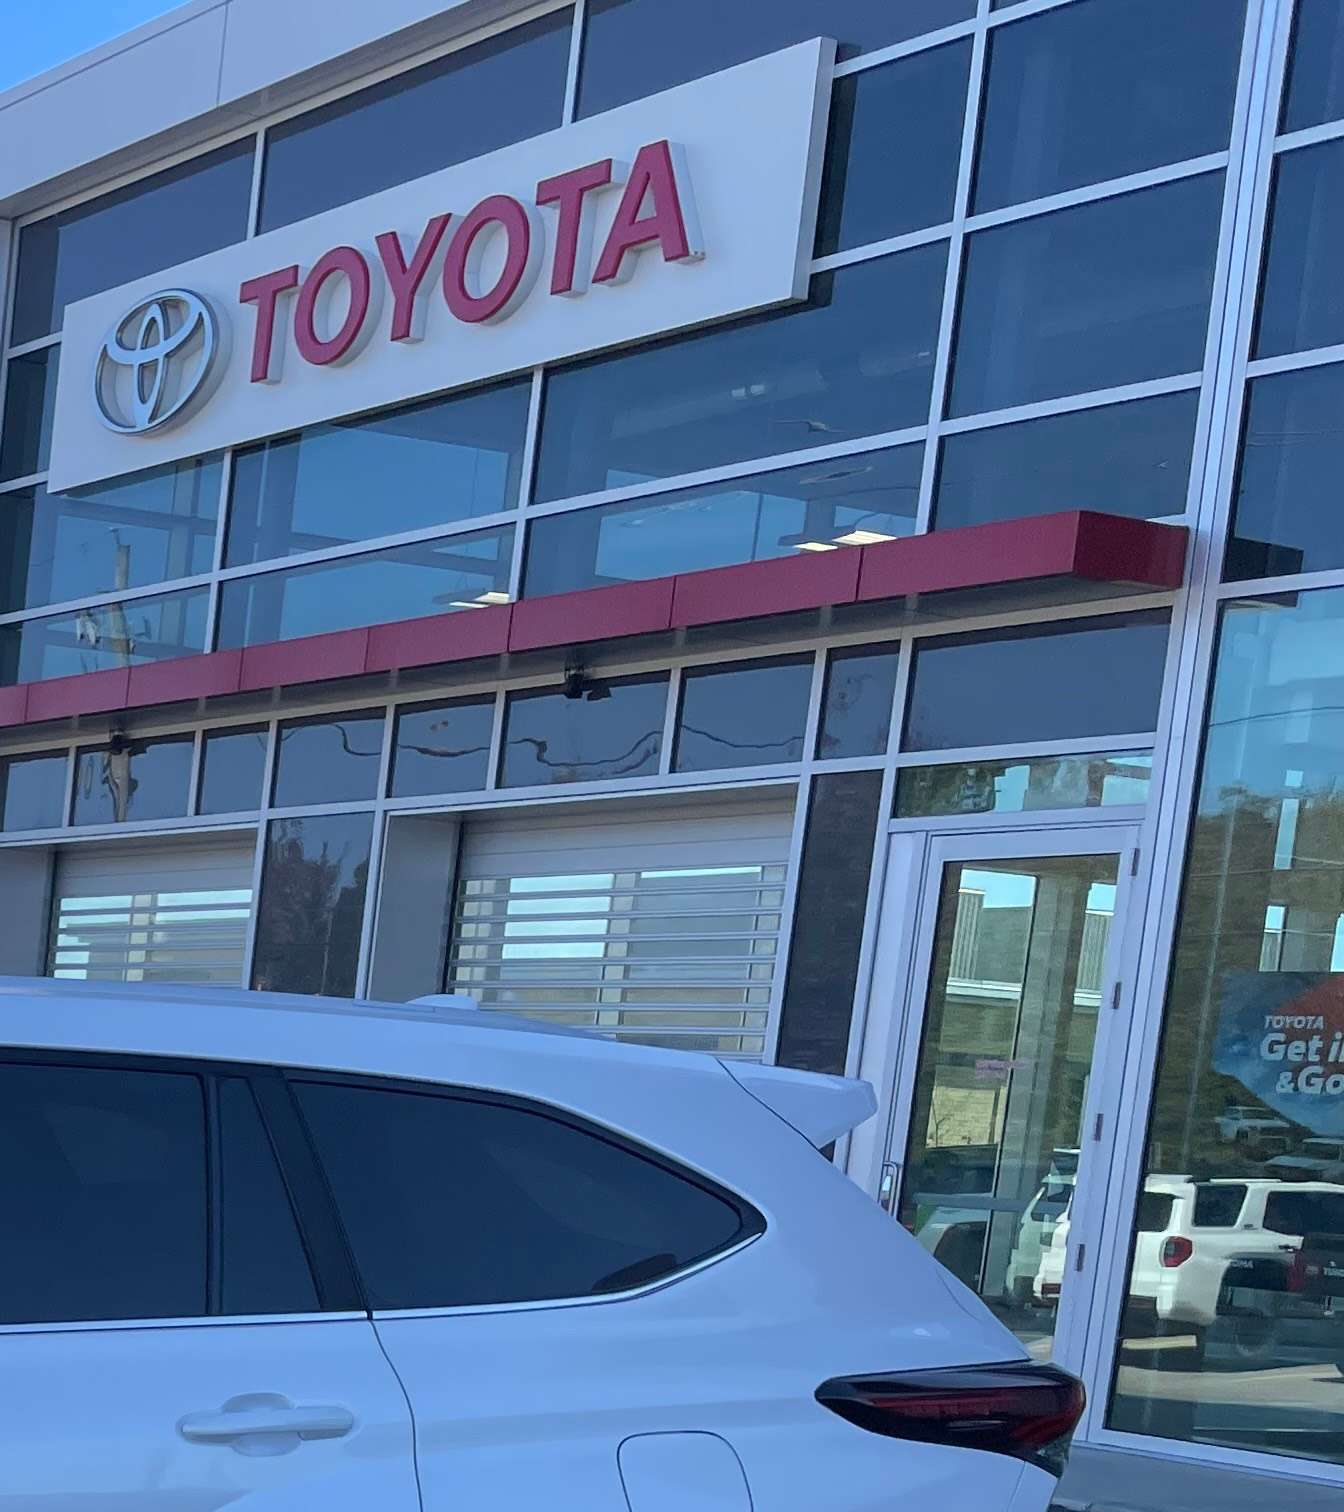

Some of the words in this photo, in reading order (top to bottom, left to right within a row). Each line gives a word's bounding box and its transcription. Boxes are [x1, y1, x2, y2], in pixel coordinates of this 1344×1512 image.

[239, 138, 696, 384] TOYOTA
[1264, 1015, 1324, 1030] TOYOTA
[1260, 1032, 1324, 1062] Get
